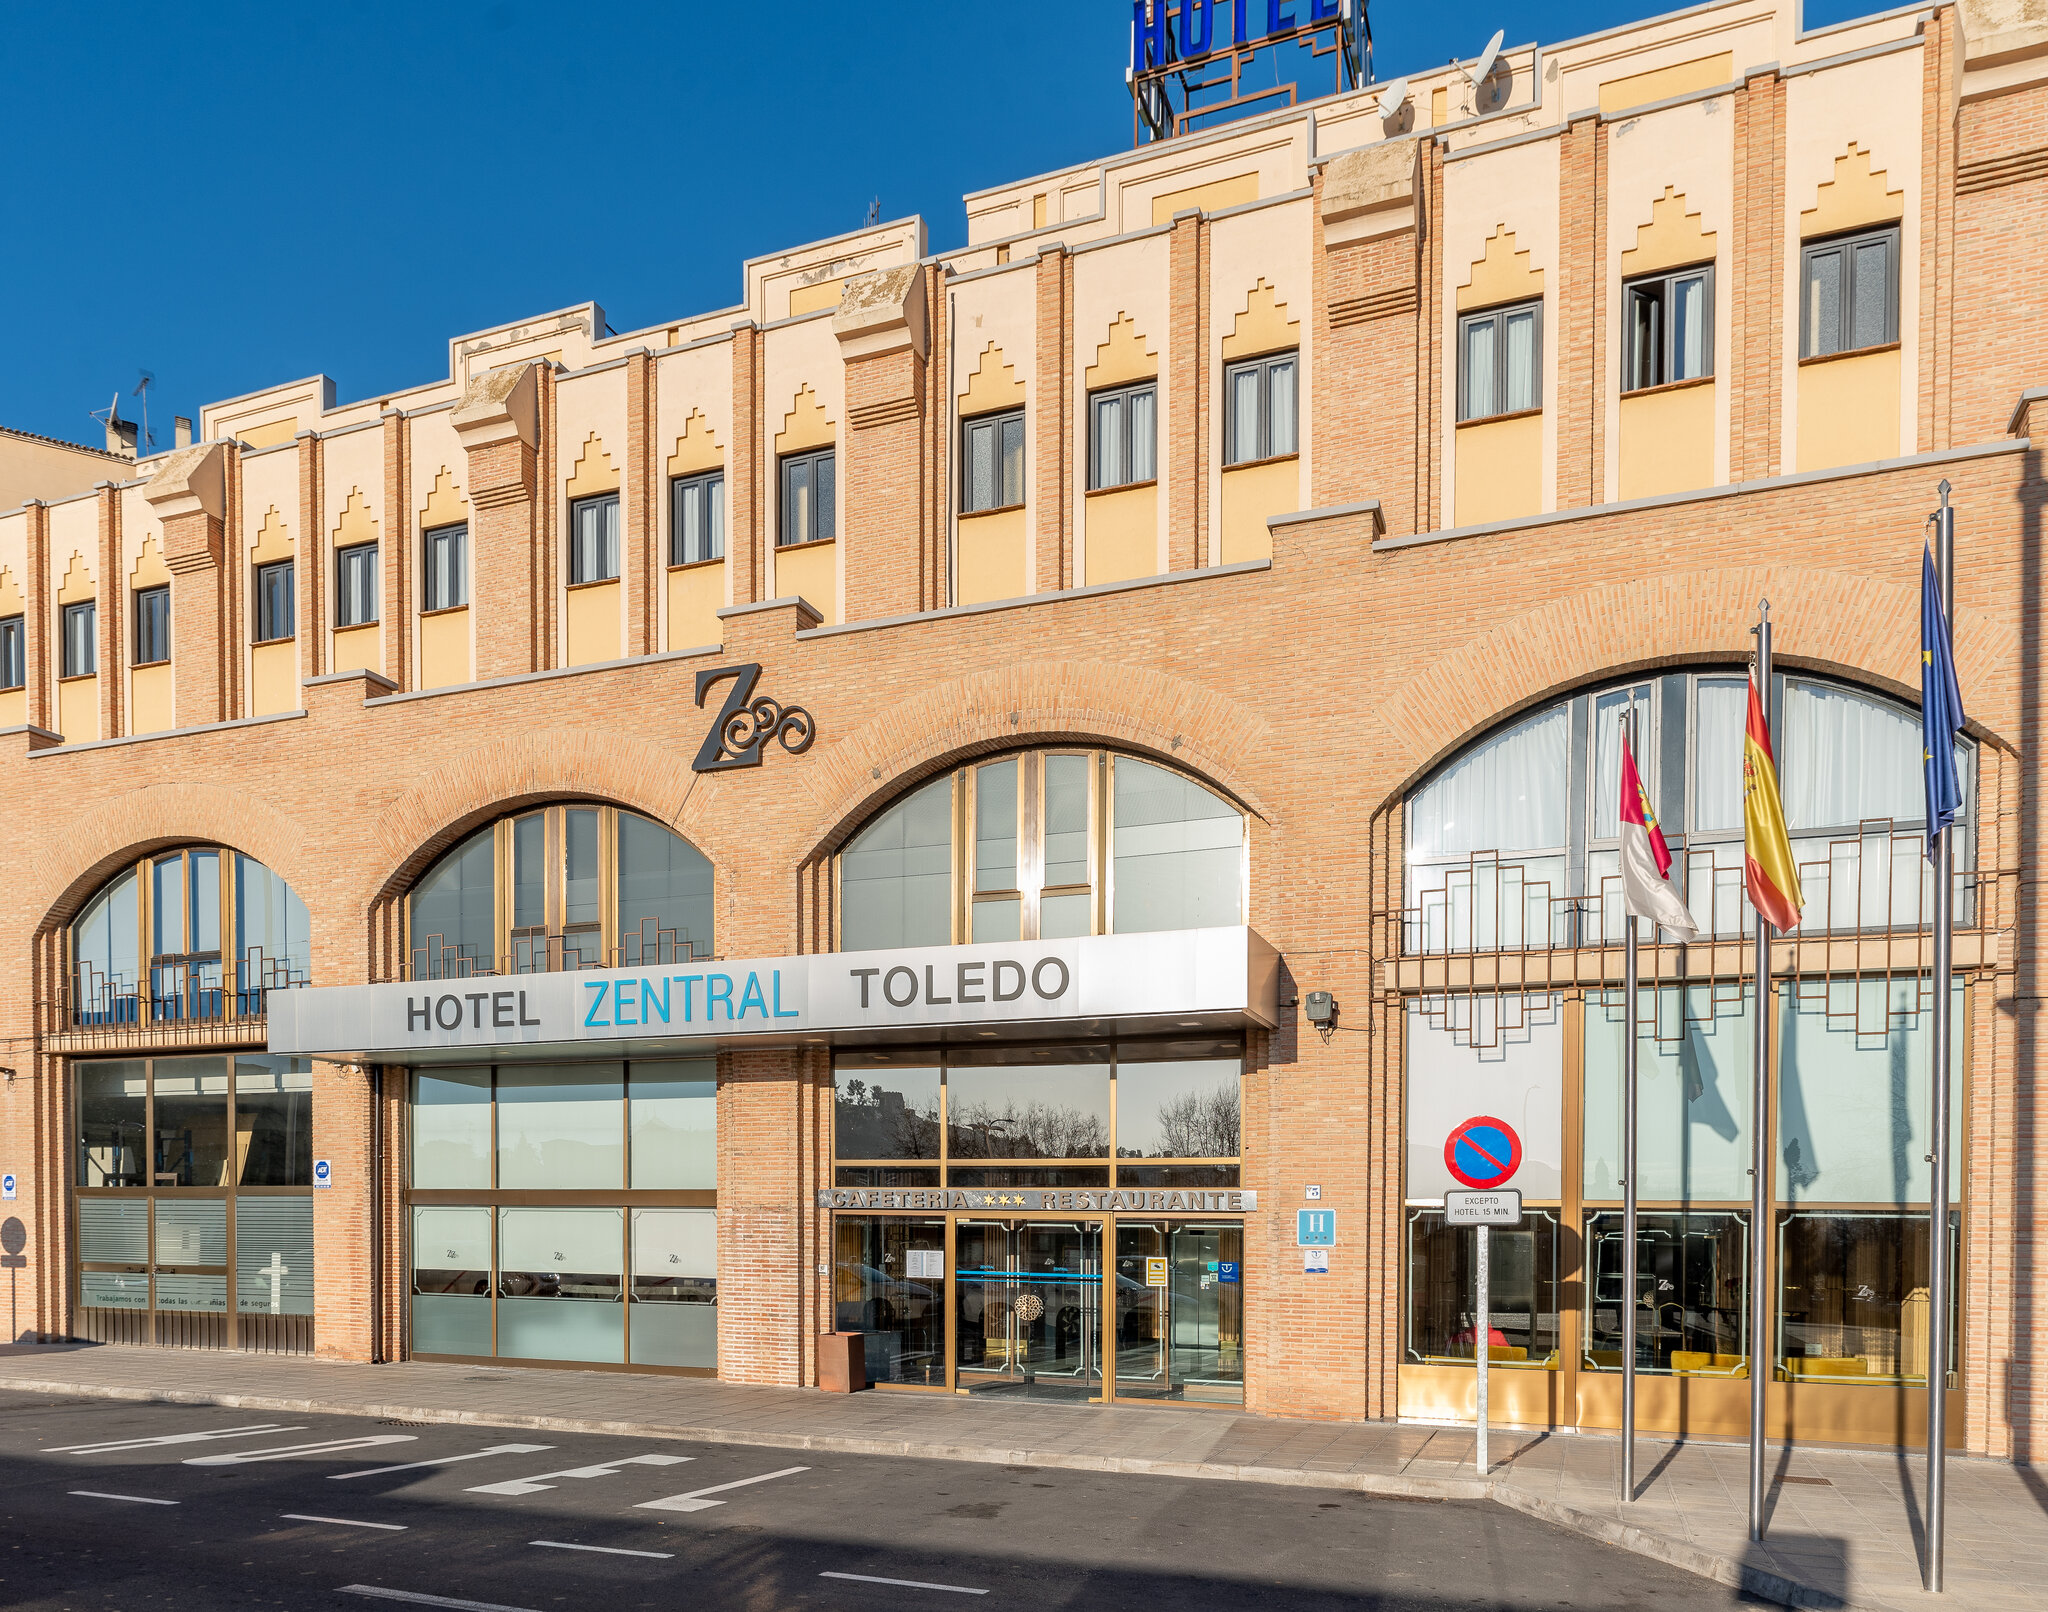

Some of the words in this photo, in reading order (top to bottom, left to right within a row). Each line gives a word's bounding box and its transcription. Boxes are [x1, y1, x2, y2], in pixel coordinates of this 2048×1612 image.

[407, 990, 541, 1031] HOTEL
[584, 970, 799, 1027] ZENTRAL
[849, 956, 1070, 1009] TOLEDO
[832, 1190, 969, 1209] CAFETERIA
[1041, 1191, 1243, 1210] RESTAURANTE
[1454, 1208, 1479, 1216] HOTEL
[1483, 1207, 1491, 1216] 15
[1493, 1208, 1509, 1216] MIN.
[1309, 1213, 1325, 1232] H
[96, 1294, 132, 1304] Trabajamos
[178, 1297, 188, 1305] las
[239, 1299, 248, 1307] de
[251, 1301, 279, 1310] seguros
